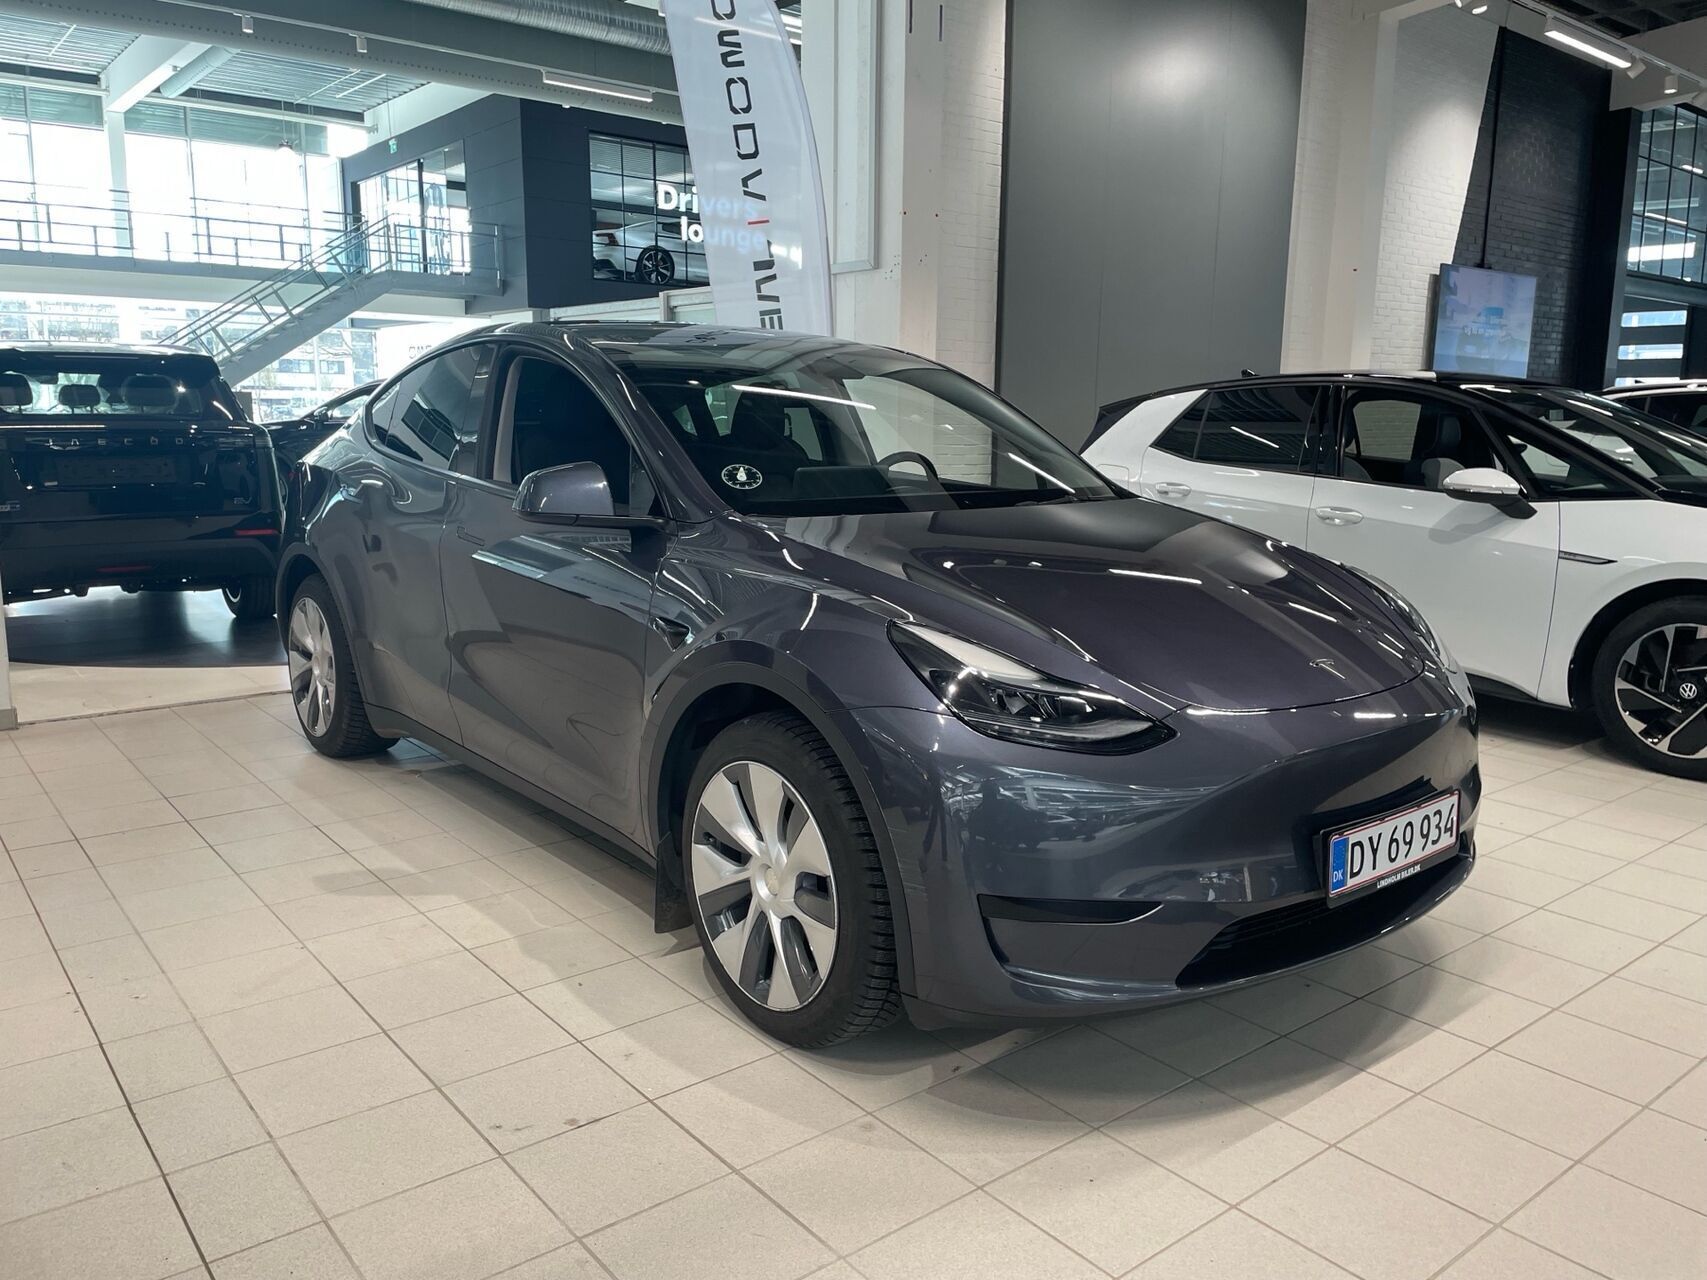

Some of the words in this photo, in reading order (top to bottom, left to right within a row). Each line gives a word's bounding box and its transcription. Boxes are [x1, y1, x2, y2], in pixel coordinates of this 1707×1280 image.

[1349, 832, 1383, 880] DY
[1387, 820, 1415, 864] 69
[1419, 803, 1456, 852] 934
[1333, 870, 1344, 883] DK
